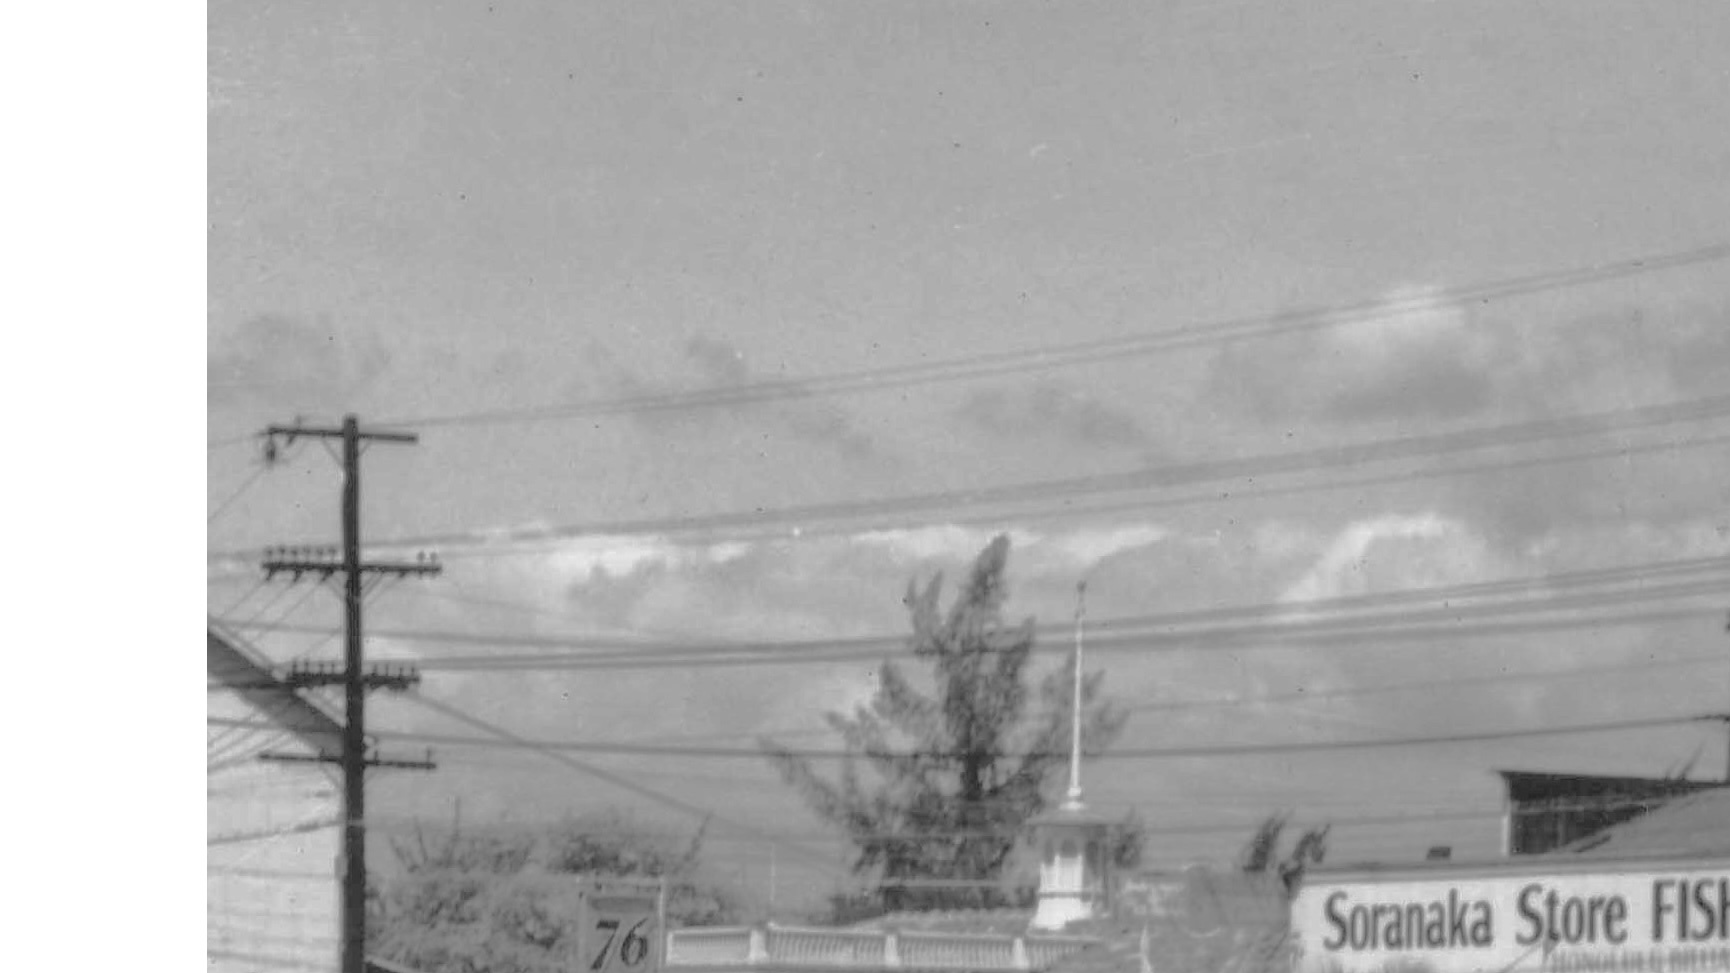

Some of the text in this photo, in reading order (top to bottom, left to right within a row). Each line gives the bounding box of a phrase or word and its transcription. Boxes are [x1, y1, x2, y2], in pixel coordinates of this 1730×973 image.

[589, 916, 648, 971] 76
[1323, 888, 1493, 951] Soranaka
[1515, 883, 1628, 948] Store
